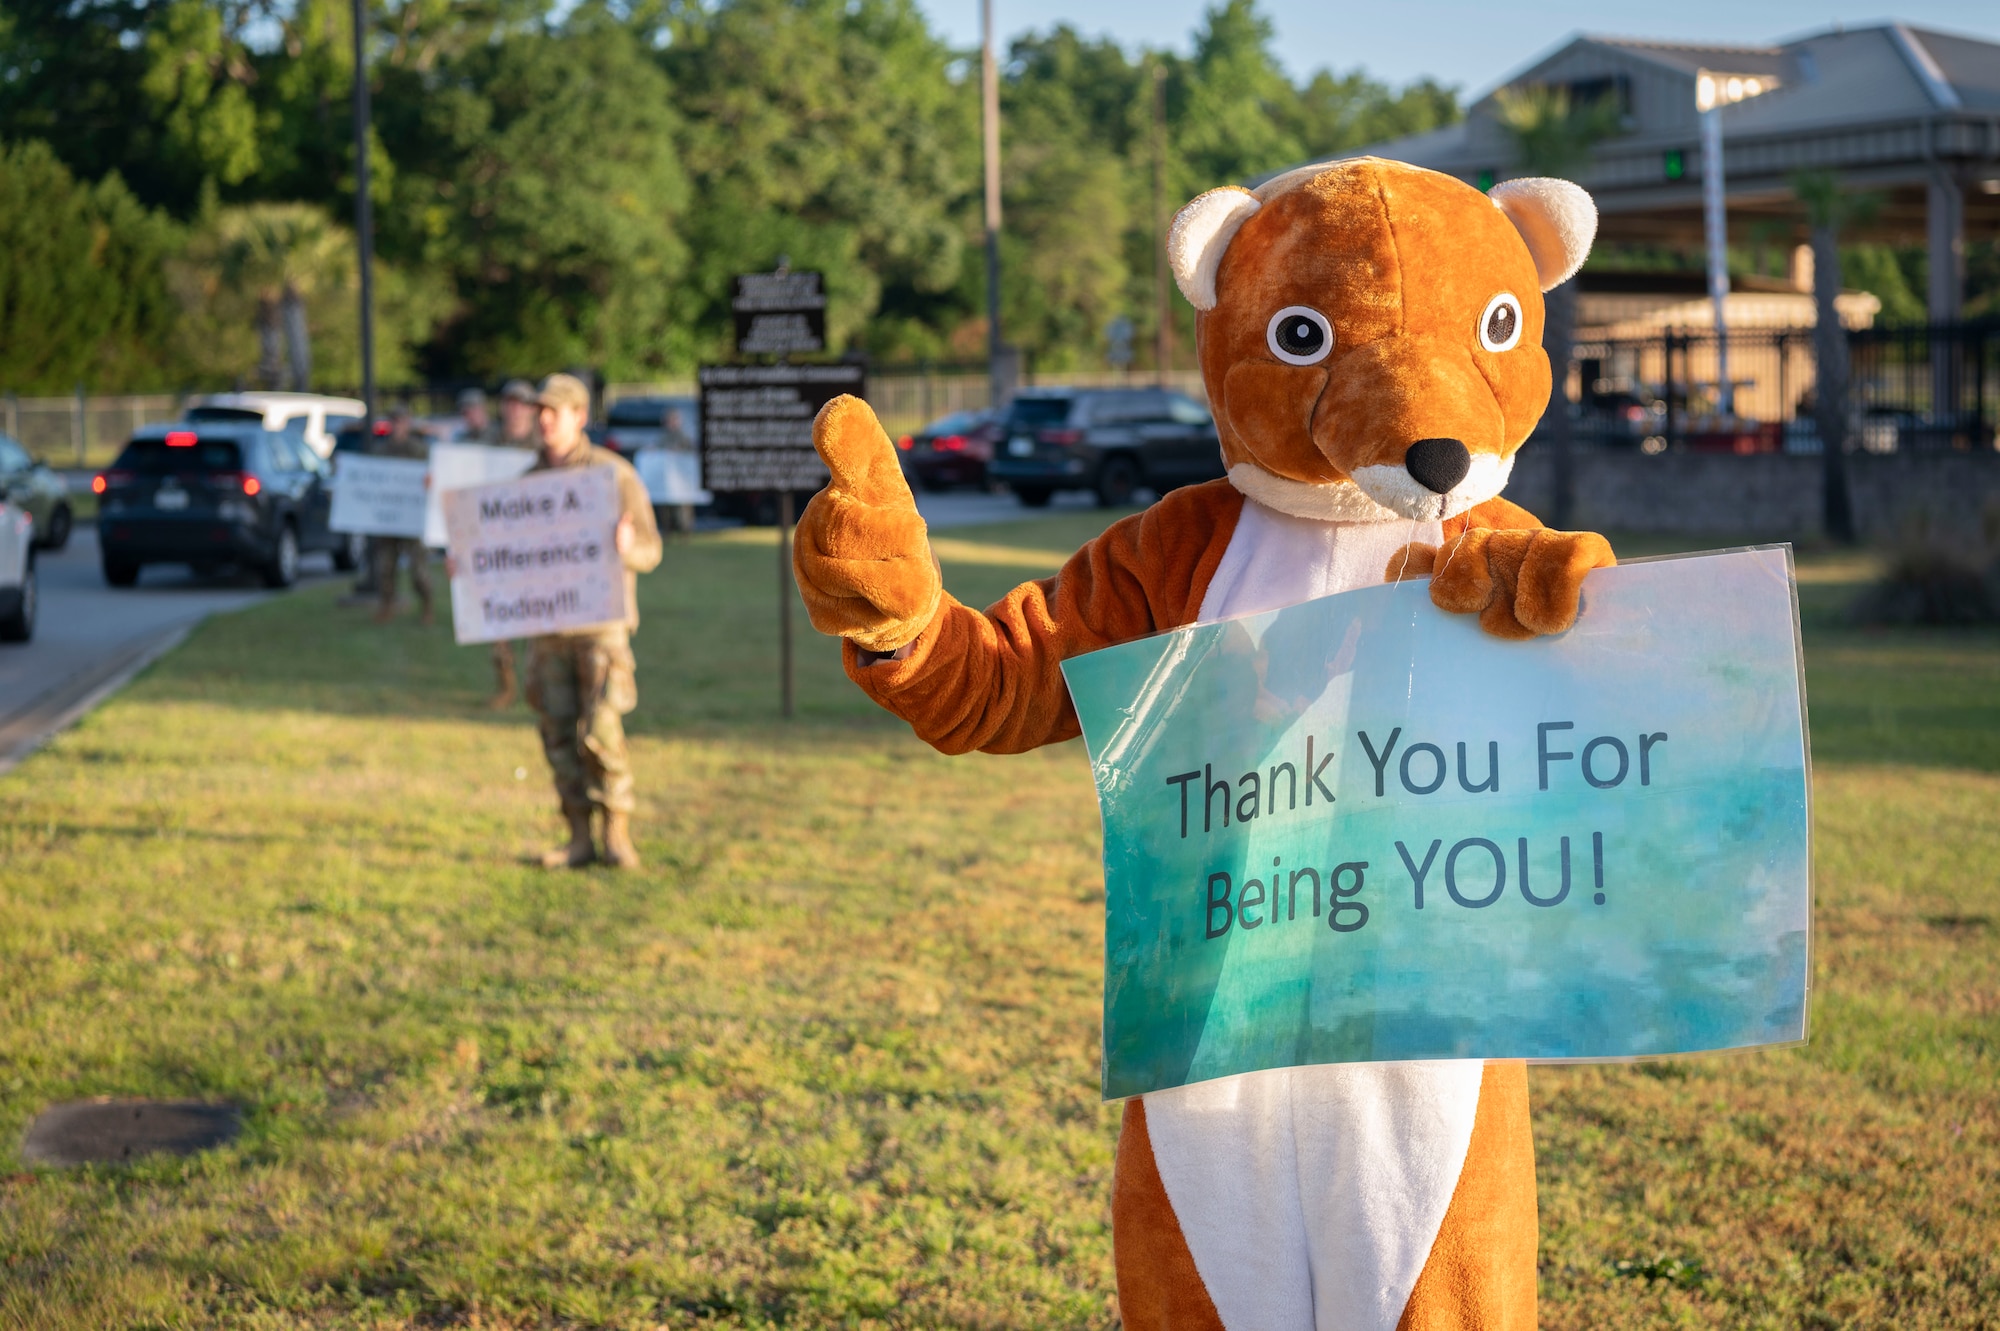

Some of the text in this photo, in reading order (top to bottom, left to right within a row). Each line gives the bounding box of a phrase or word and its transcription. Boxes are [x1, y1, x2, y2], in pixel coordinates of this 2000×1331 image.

[480, 490, 580, 521] Make A
[473, 541, 600, 573] Difference
[1166, 721, 1668, 839] Thank You For
[1205, 831, 1606, 940] Being YOU!
